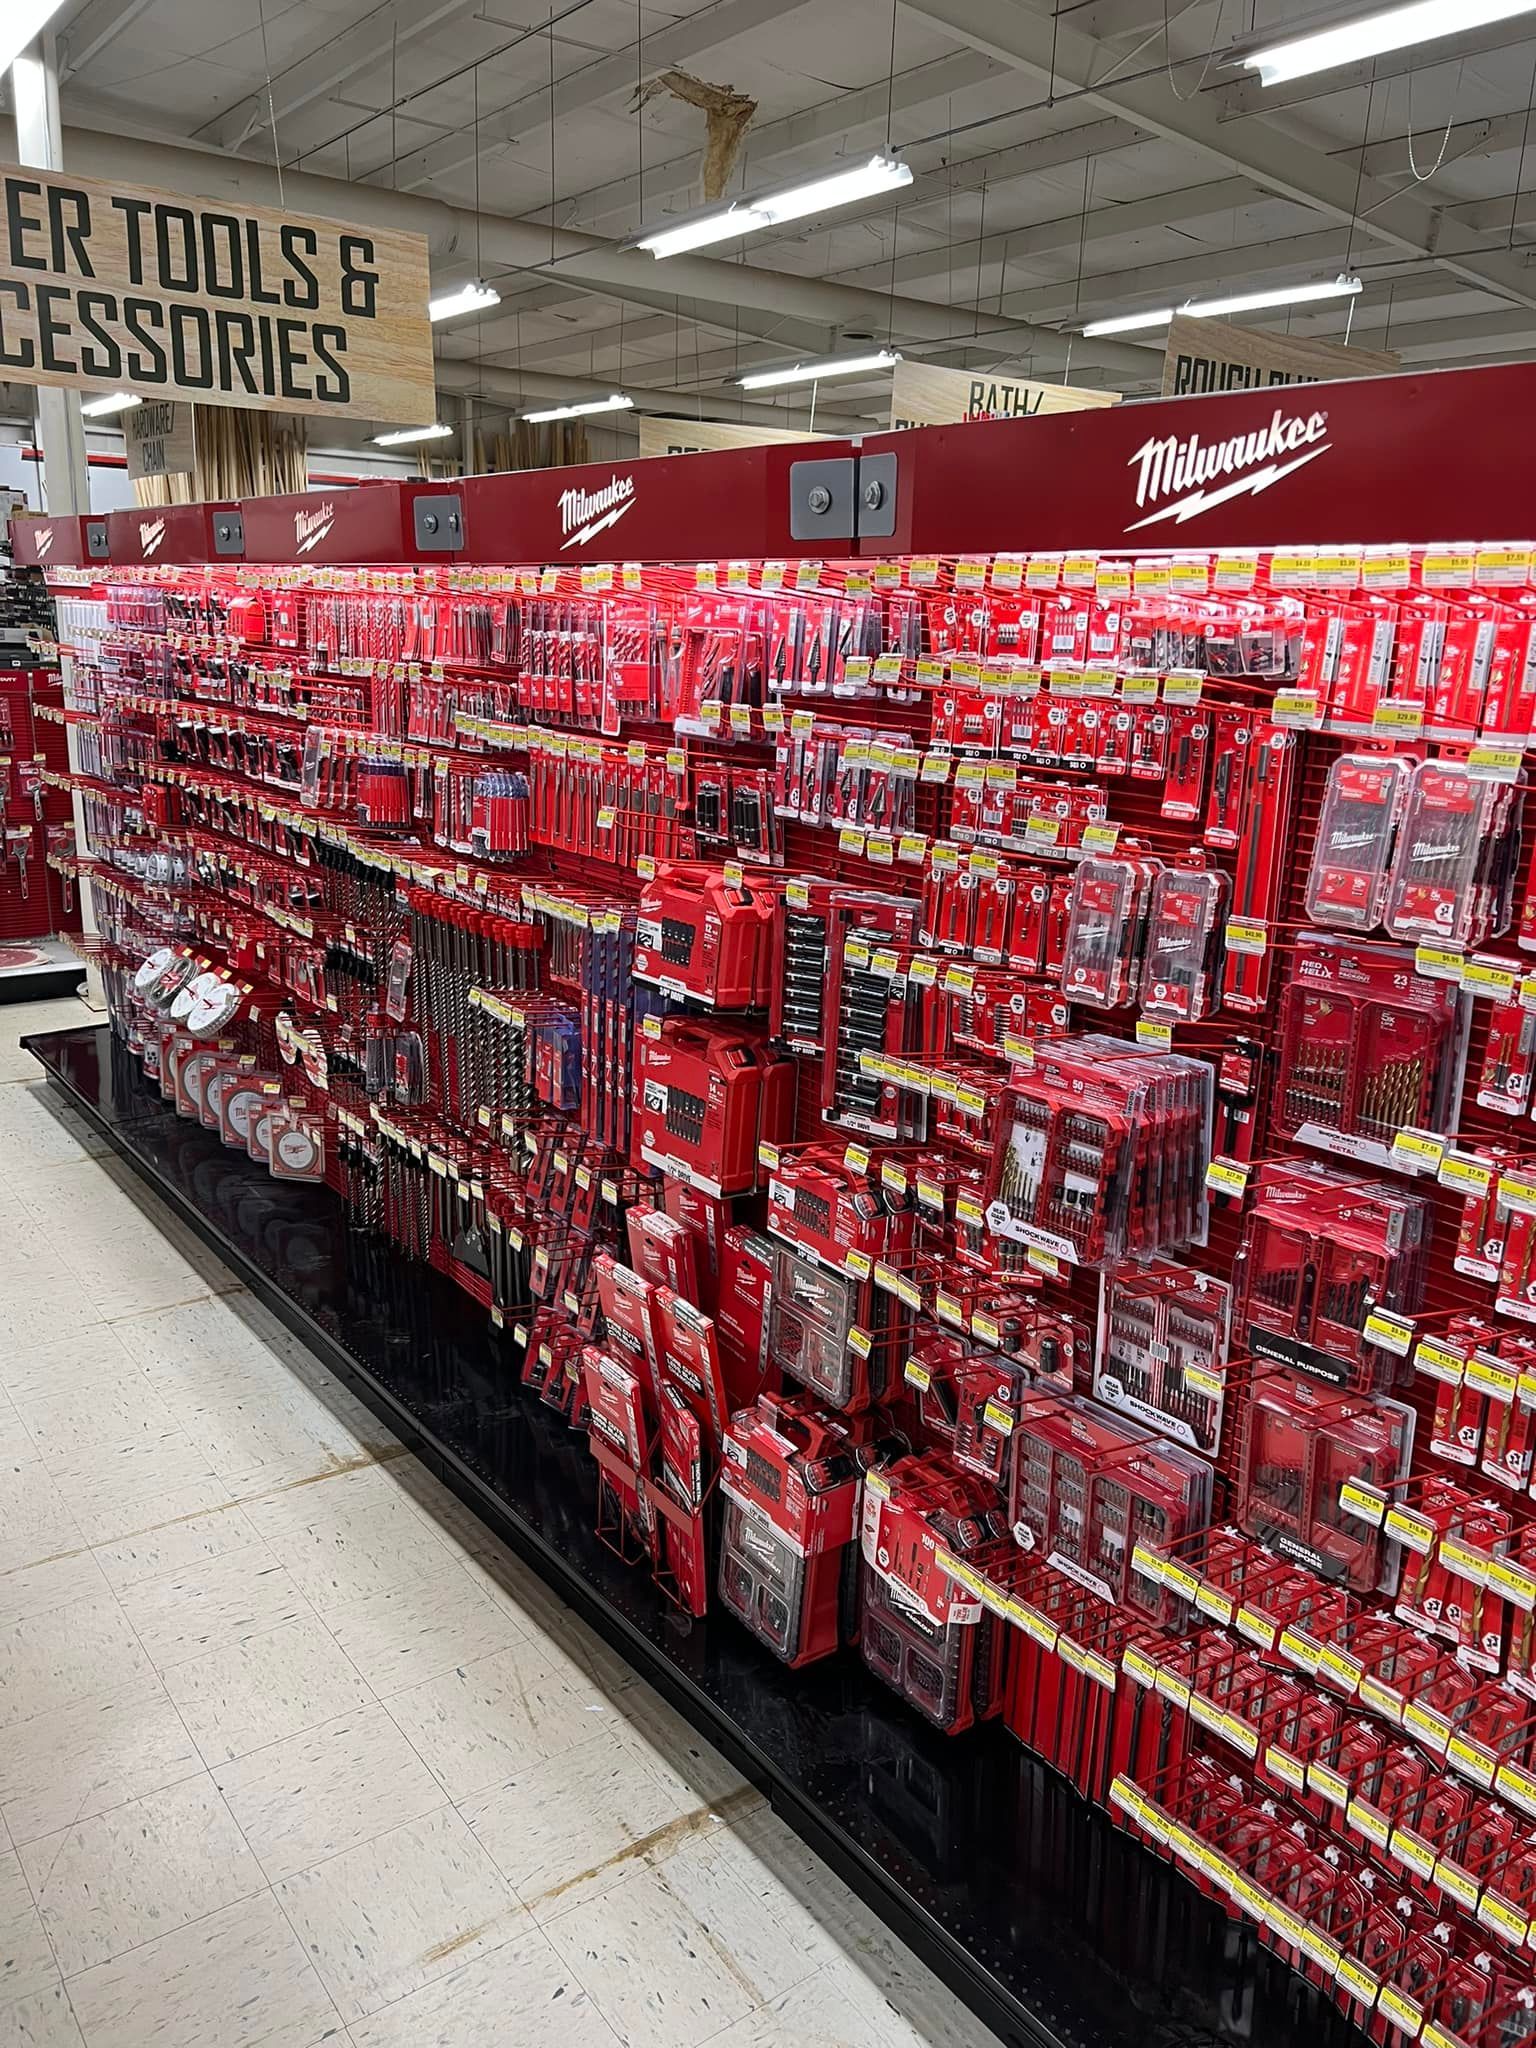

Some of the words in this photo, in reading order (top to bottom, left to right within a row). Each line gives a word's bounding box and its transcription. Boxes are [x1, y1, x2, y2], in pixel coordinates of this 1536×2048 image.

[5, 178, 95, 278] ER
[111, 196, 319, 310] TOOLS
[339, 235, 379, 318] &
[0, 279, 350, 403] CESSORIES
[1127, 409, 1327, 507] Milwaukee
[557, 474, 634, 535] Milwaukee
[1331, 831, 1375, 846] Milwaukee
[1412, 842, 1460, 857] Milwaukee
[1299, 965, 1333, 979] HELIX
[1301, 960, 1321, 968] RED
[1393, 974, 1407, 986] 23
[1072, 1080, 1083, 1090] 50
[1329, 1143, 1356, 1155] METAL
[1265, 1186, 1307, 1199] Milwaukee
[1015, 1224, 1060, 1248] SHOCKWAVE
[1165, 1278, 1176, 1288] 54
[1255, 1344, 1295, 1365] GENERAL
[1297, 1360, 1340, 1382] PURPOSE
[1130, 1401, 1176, 1426] SHOCKWAVE
[921, 1533, 935, 1549] 100
[1279, 1544, 1322, 1569] PURPOSE
[1280, 1537, 1322, 1562] GENERAL
